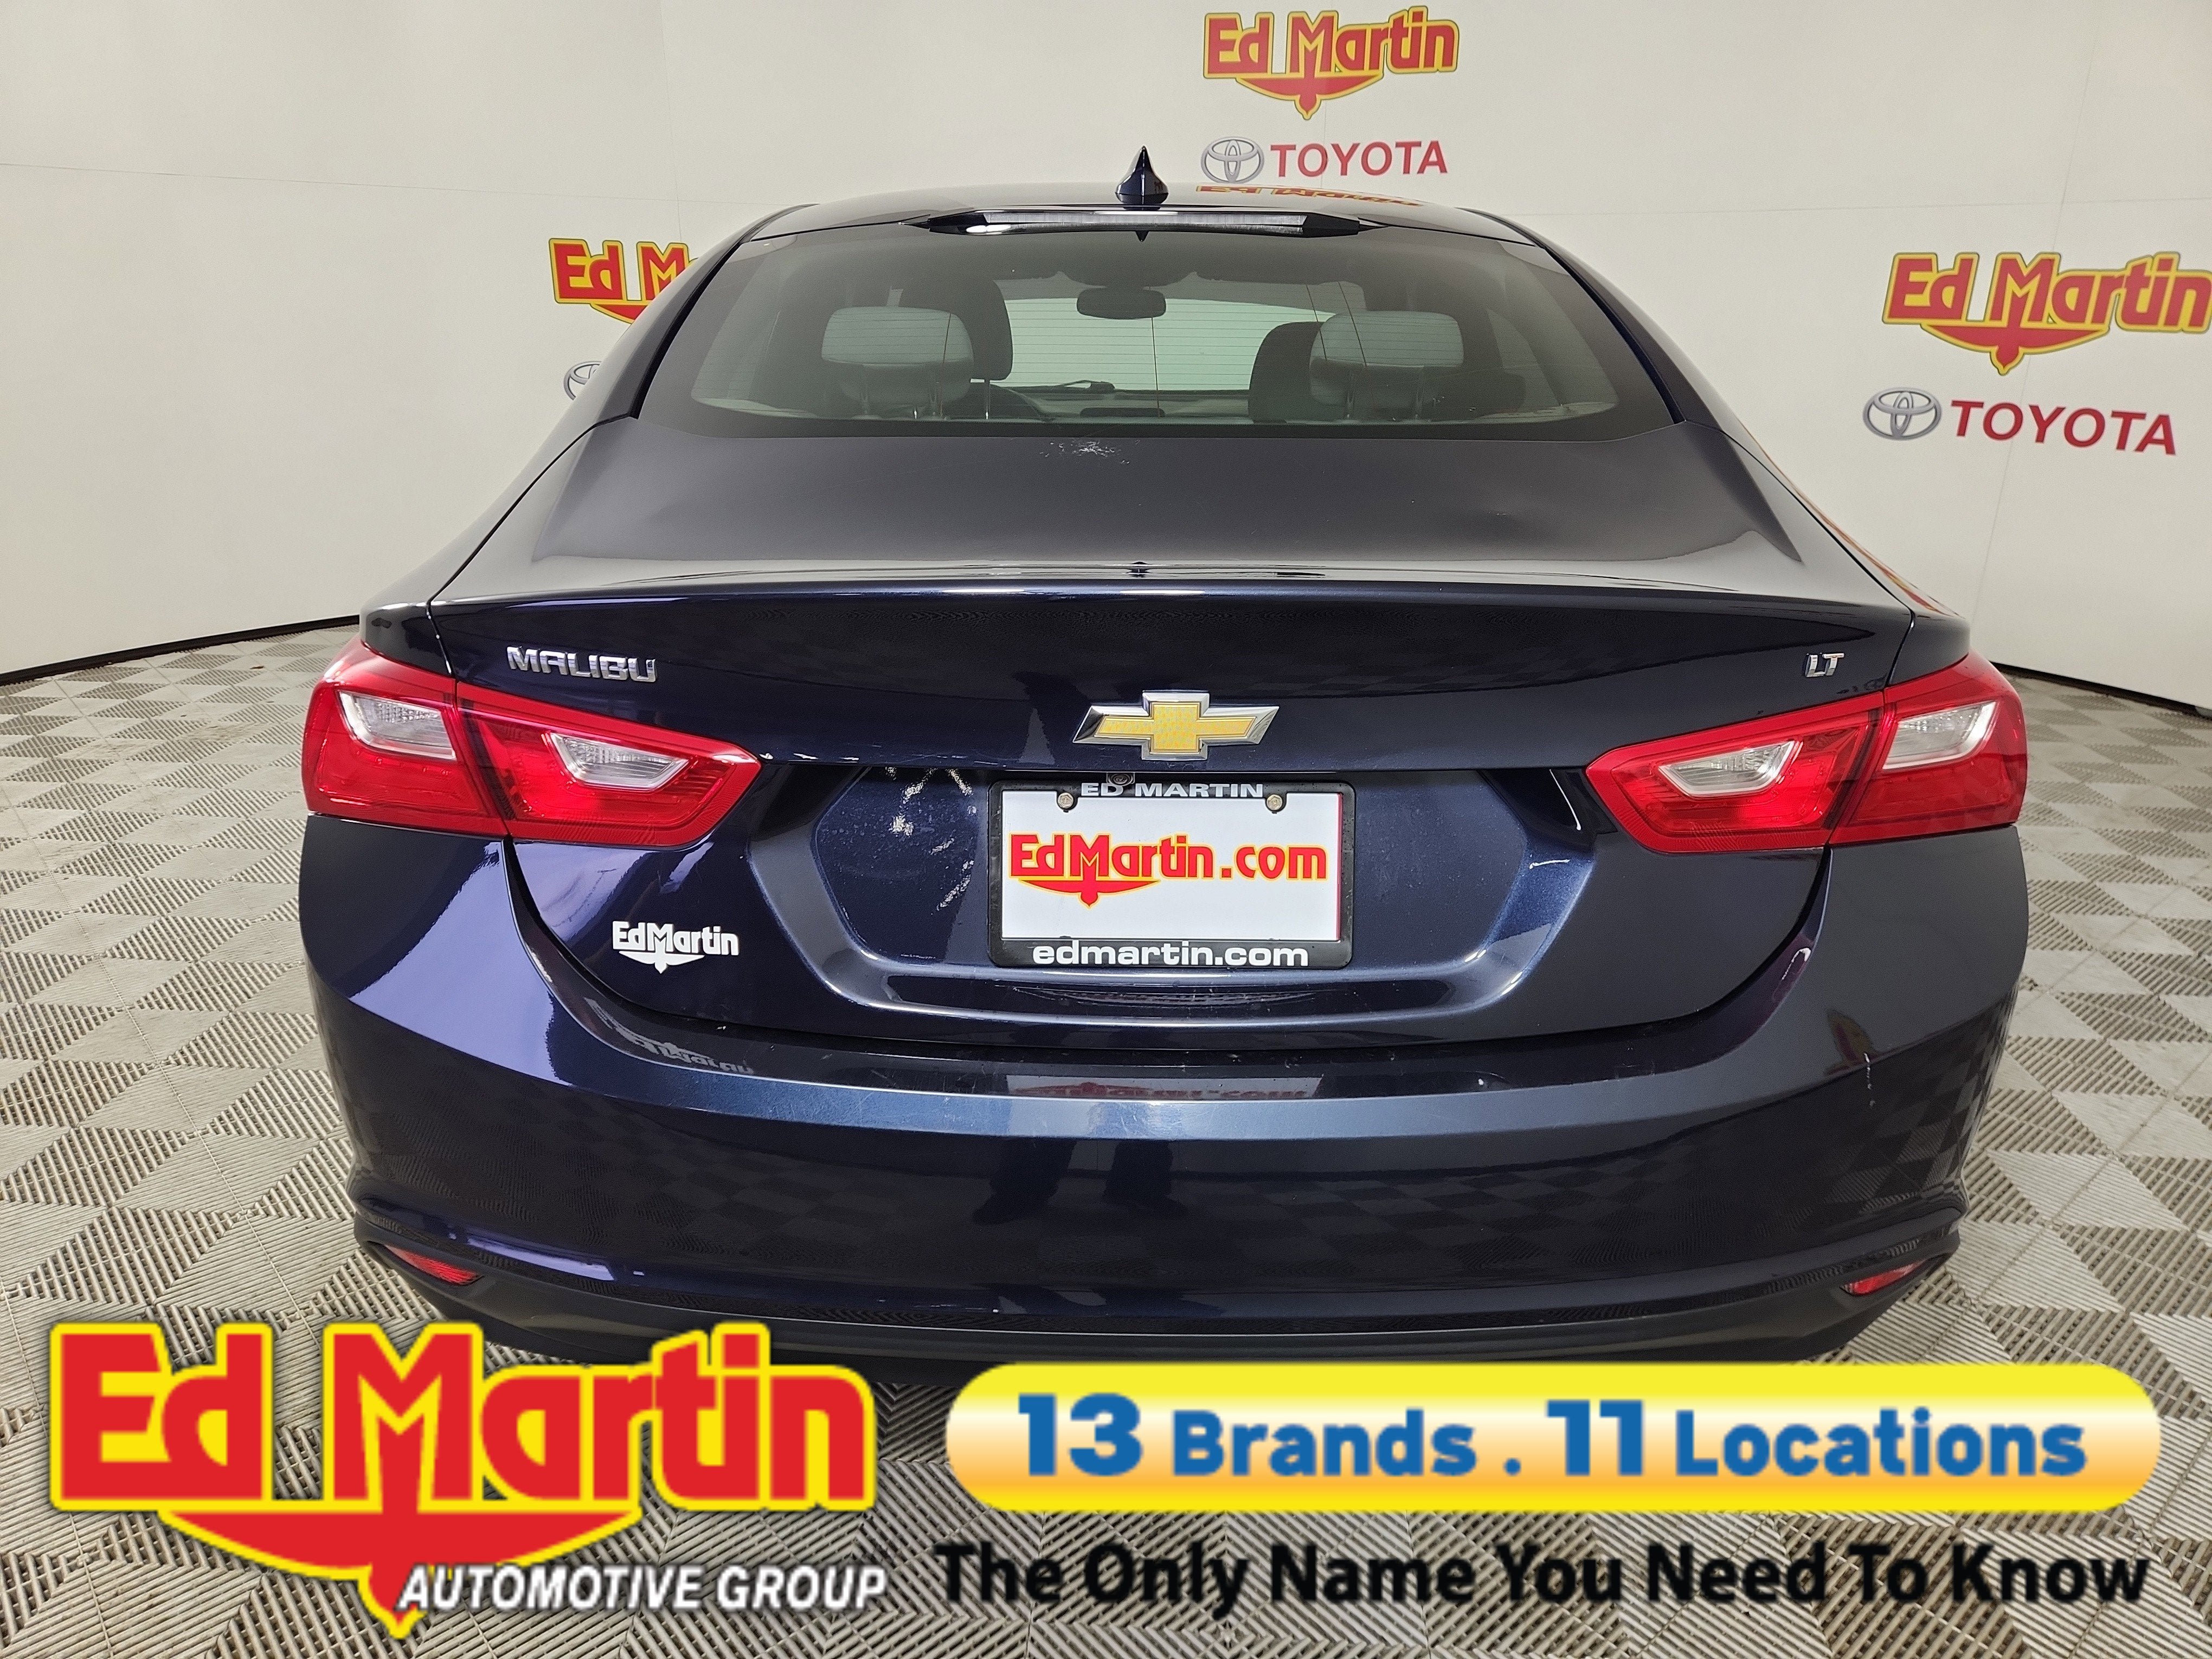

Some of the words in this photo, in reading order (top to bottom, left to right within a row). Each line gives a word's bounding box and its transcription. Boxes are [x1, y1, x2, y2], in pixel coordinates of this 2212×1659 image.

[1204, 12, 1274, 79] Ed
[1286, 6, 1459, 76] Martin
[1270, 140, 1448, 177] TOYOTA
[549, 238, 627, 304] Ed
[1882, 252, 1979, 324] Ed
[1984, 251, 2212, 333] Martin
[1951, 399, 2176, 455] TOYOTA
[507, 646, 657, 682] MALIBU
[1805, 652, 1844, 678] LT
[1081, 783, 1123, 797] ED
[1135, 783, 1263, 798] MARTIN
[1033, 941, 1308, 967] edmartin.com
